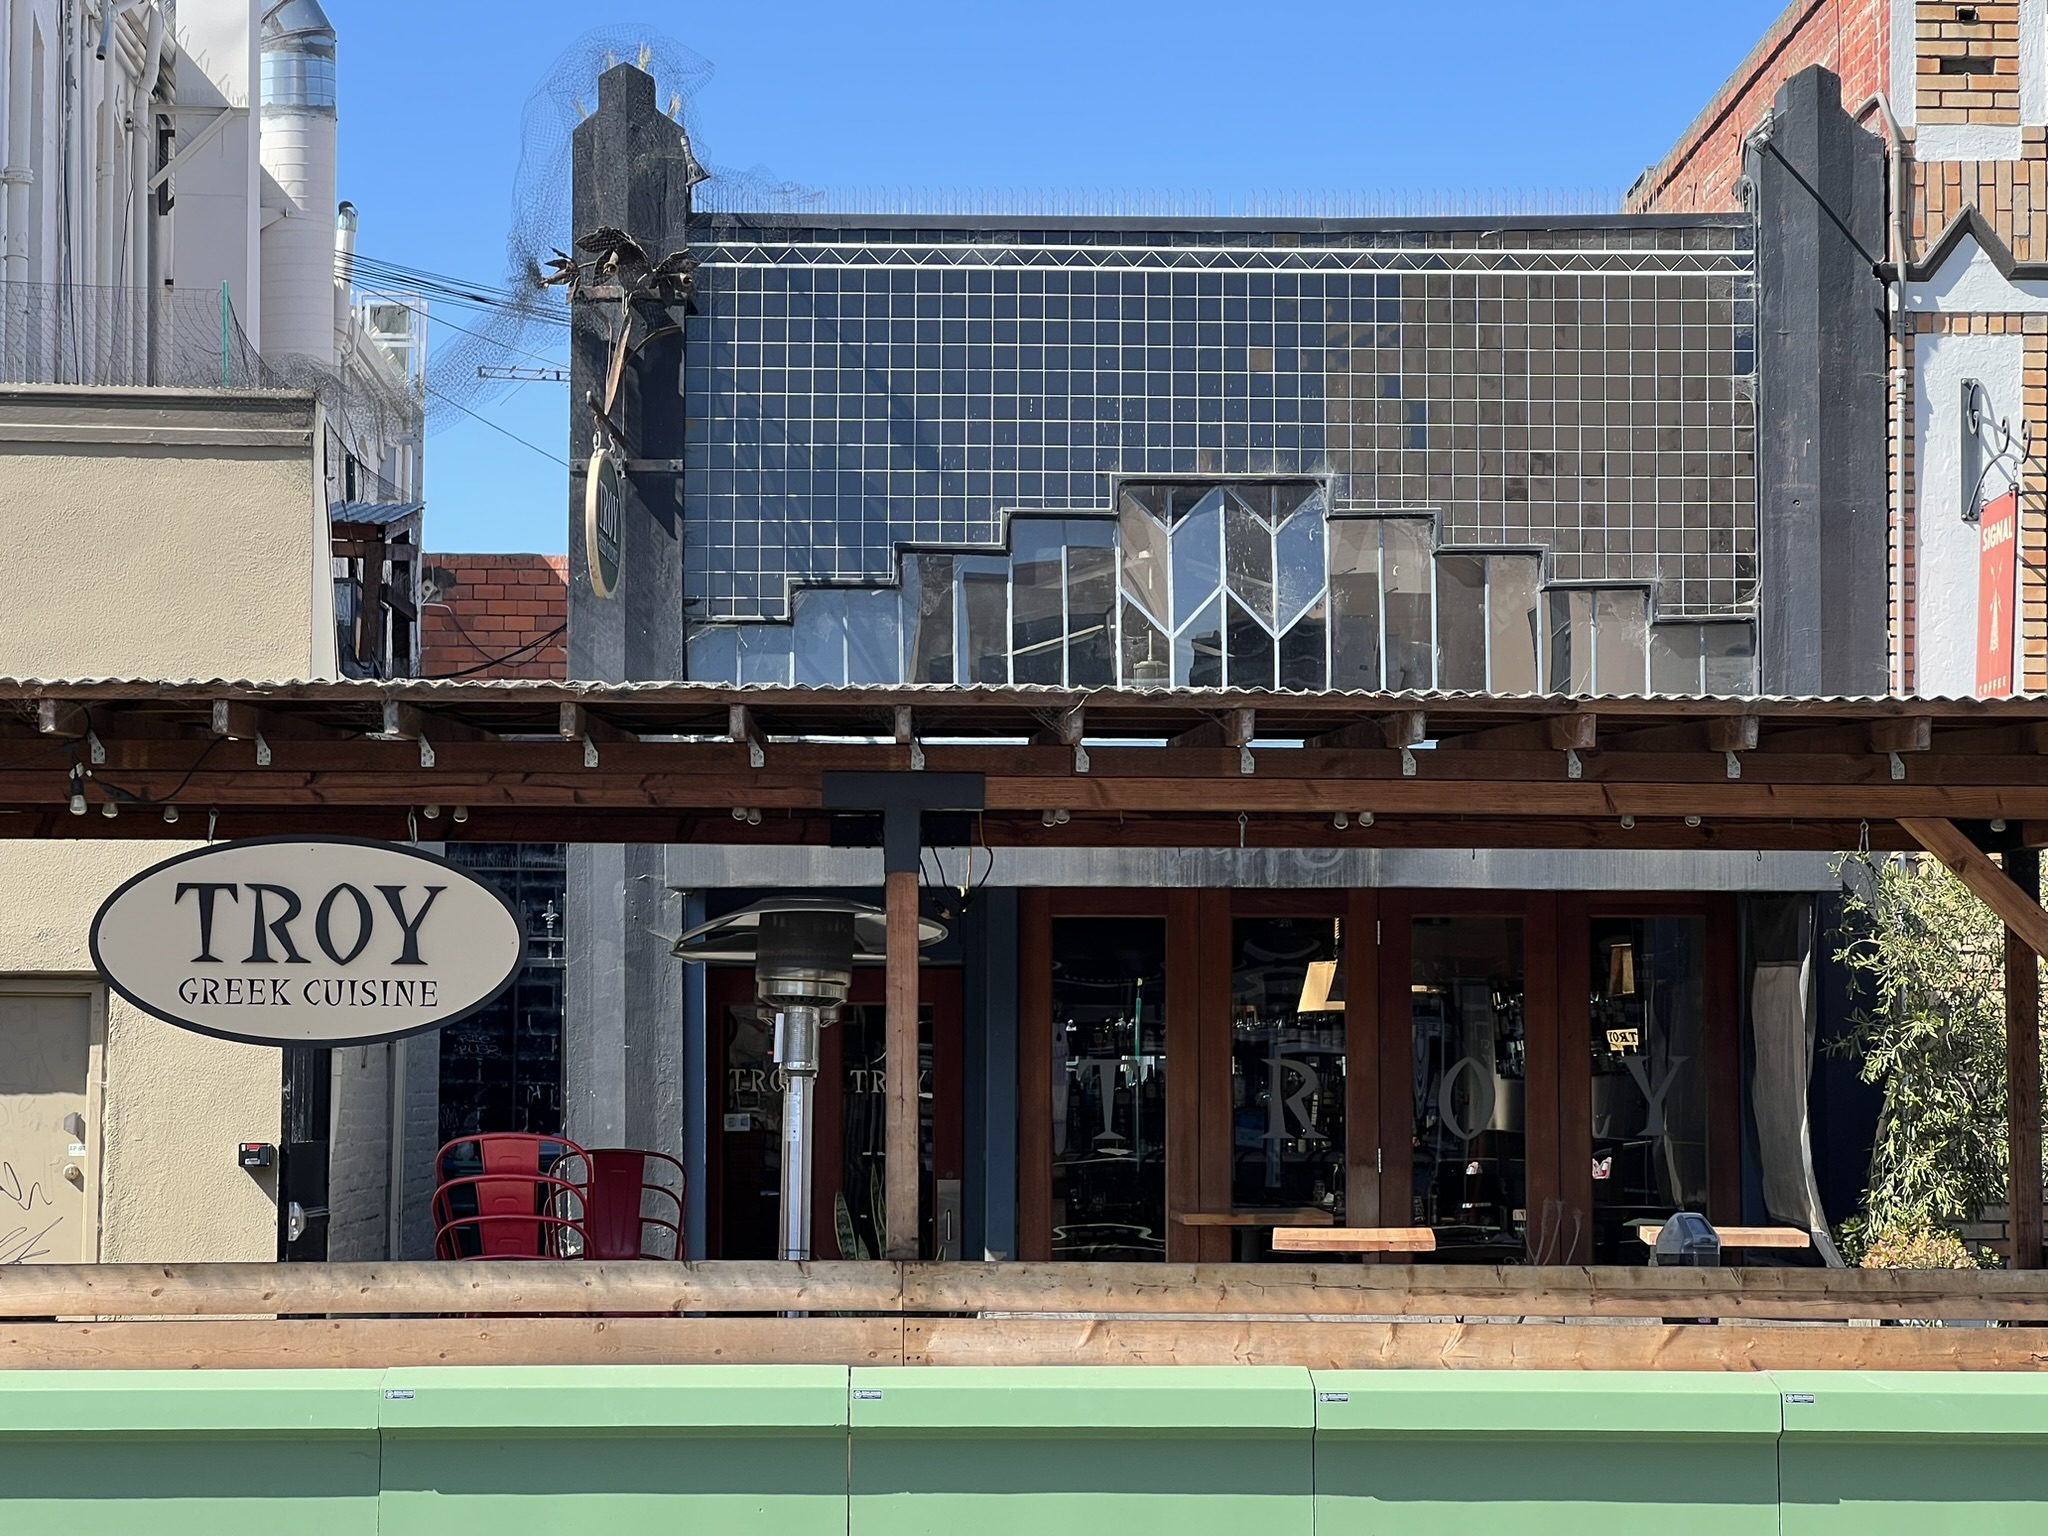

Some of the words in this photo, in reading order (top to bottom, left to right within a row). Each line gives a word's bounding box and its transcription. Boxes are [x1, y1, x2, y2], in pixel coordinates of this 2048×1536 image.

[599, 480, 619, 544] TROY
[1982, 515, 2013, 552] SIGNAL
[1978, 675, 2007, 697] COFFEE
[174, 882, 448, 966] TROY
[178, 976, 291, 1007] GREEK
[303, 978, 439, 1008] CUISINE
[729, 1068, 785, 1093] TRO
[850, 1069, 928, 1094] TR
